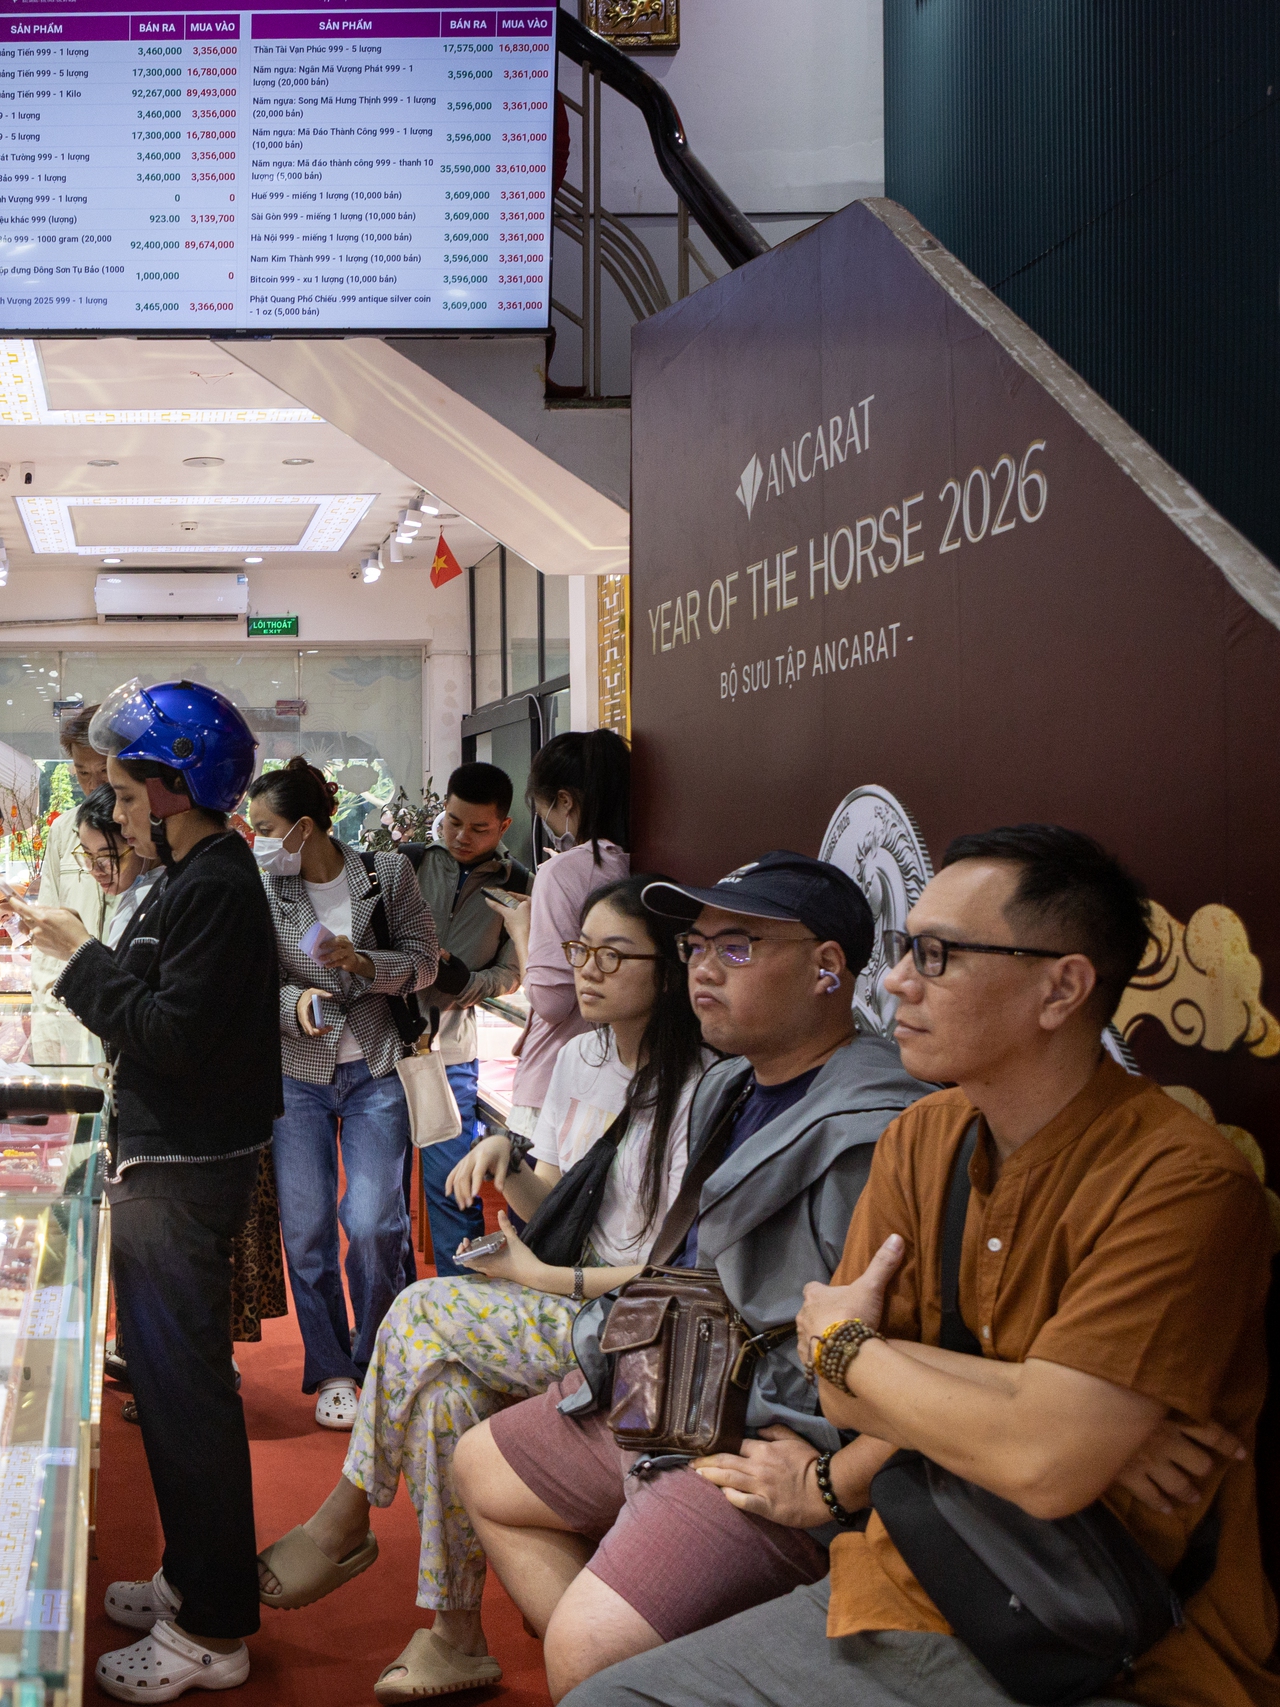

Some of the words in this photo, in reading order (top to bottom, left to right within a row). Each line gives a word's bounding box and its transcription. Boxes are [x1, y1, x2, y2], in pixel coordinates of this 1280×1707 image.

[139, 22, 160, 33] BÁN
[162, 24, 176, 32] RA
[190, 23, 213, 32] MUA
[215, 20, 235, 32] VÀO
[450, 18, 471, 29] BÁN
[473, 20, 487, 29] RA
[502, 20, 525, 29] MUA
[527, 18, 548, 28] VÀO
[66, 48, 89, 57] lượng
[138, 46, 182, 56] 3,460,000
[193, 46, 237, 56] 3,356,000
[289, 45, 305, 54] Vạn
[359, 44, 382, 54] lượng
[443, 43, 494, 54] 17,575,000
[499, 43, 549, 53] 16,830,000
[132, 68, 182, 78] 17,300,000
[187, 67, 237, 77] 16,780,000
[448, 70, 493, 80] 3,596,000
[504, 70, 549, 80] 3,361,000
[132, 88, 182, 99] 92,267,000
[186, 88, 237, 98] 89,493,000
[447, 102, 492, 111] 3,596,000
[503, 101, 548, 111] 3,361,000
[18, 111, 40, 121] lượng
[137, 110, 181, 120] 3,460,000
[192, 109, 236, 119] 3,356,000
[132, 131, 181, 141] 17,300,000
[187, 130, 236, 140] 16,780,000
[446, 133, 491, 143] 3,596,000
[502, 133, 547, 142] 3,361,000
[137, 151, 181, 161] 3,460,000
[191, 151, 236, 161] 3,356,000
[440, 164, 491, 174] 35,590,000
[496, 164, 546, 174] 33,610,000
[136, 172, 181, 182] 3,460,000
[191, 172, 235, 182] 3,356,000
[174, 194, 181, 202] 0
[229, 193, 235, 201] 0
[326, 191, 349, 201] lượng
[351, 191, 382, 200] (10,000
[445, 191, 490, 200] 3,609,000
[501, 191, 545, 200] 3,361,000
[48, 215, 77, 225] (lượng)
[149, 214, 180, 222] 923.00
[191, 214, 235, 224] 3,139,700
[340, 212, 363, 222] lượng
[365, 212, 396, 221] (10,000
[445, 212, 489, 221] 3,609,000
[500, 212, 545, 221] 3,361,000
[264, 233, 277, 243] Nội
[336, 233, 359, 243] lượng
[361, 233, 392, 242] (10,000
[444, 233, 489, 242] 3,609,000
[499, 233, 544, 243] 3,361,000
[130, 240, 180, 250] 92,400,000
[185, 240, 234, 250] 89,674,000
[345, 254, 368, 264] lượng
[370, 254, 401, 263] (10,000
[443, 254, 488, 263] 3,596,000
[499, 254, 544, 264] 3,361,000
[136, 272, 180, 281] 1,000,000
[321, 275, 344, 285] lượng
[346, 275, 377, 284] (10,000
[443, 275, 488, 284] 3,596,000
[498, 275, 543, 284] 3,361,000
[135, 302, 179, 312] 3,465,000
[190, 302, 234, 312] 3,366,000
[442, 301, 487, 311] 3,609,000
[498, 301, 542, 311] 3,361,000
[765, 394, 875, 502] ANCARAT
[648, 589, 701, 655] YEAR
[708, 572, 740, 636] OF
[746, 545, 798, 623] THE
[809, 490, 925, 600] HORSE
[938, 438, 1048, 555] 2026
[266, 620, 292, 628] THOÁT
[720, 660, 738, 702] BỘ
[741, 656, 772, 695] SƯU
[775, 644, 807, 689] TẬP
[812, 621, 901, 678] ANCARAT
[836, 812, 850, 839] 2026
